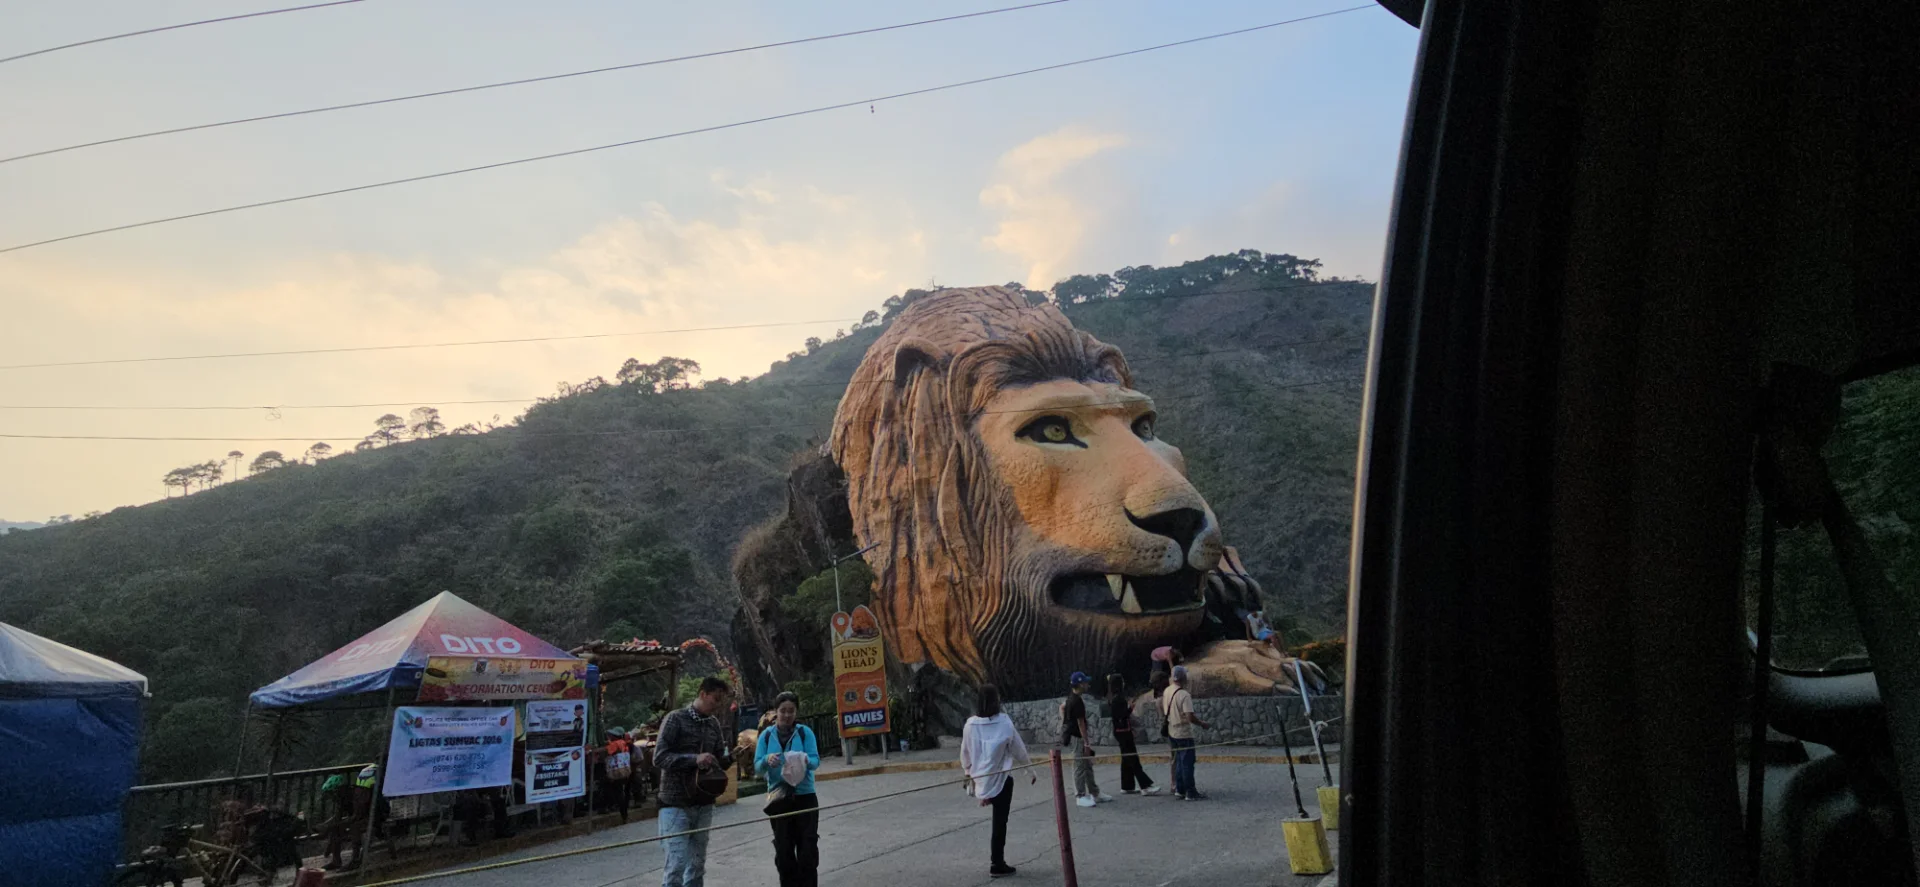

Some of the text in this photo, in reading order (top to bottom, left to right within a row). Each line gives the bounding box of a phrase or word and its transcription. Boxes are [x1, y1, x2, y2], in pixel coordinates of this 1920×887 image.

[338, 634, 407, 662] DITO
[440, 634, 521, 654] DITO
[841, 647, 877, 660] LION'S
[529, 658, 556, 669] DITO
[844, 657, 876, 669] HEAD
[844, 710, 884, 725] DAVIES
[409, 737, 441, 748] LIGTAS
[443, 735, 481, 747] SUMVAC
[535, 770, 568, 780] ASSISTANCE
[543, 779, 559, 787] DESK
